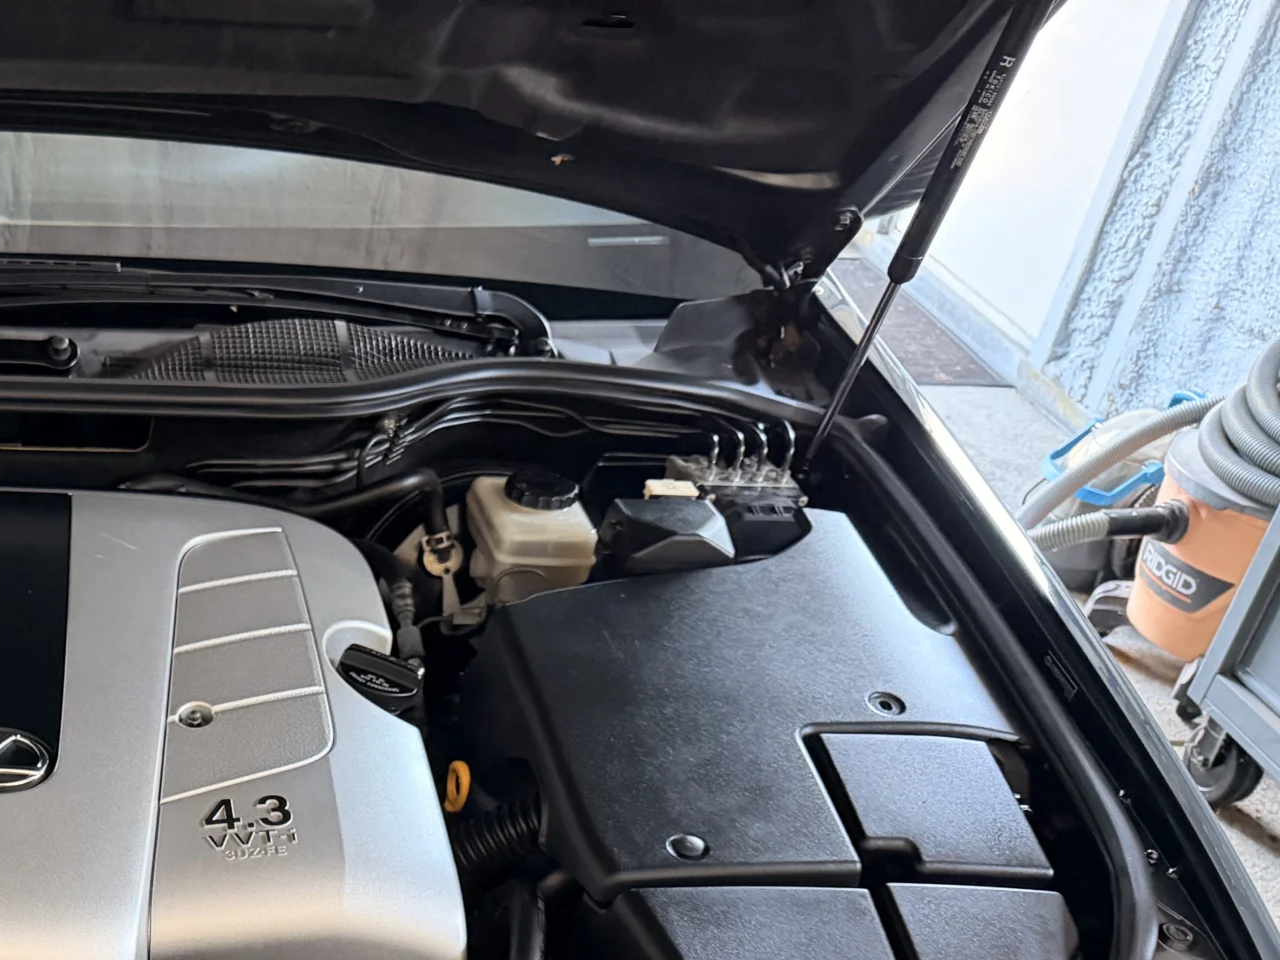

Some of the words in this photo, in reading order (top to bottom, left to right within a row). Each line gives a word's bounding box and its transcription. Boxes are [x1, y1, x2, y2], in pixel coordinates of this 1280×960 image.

[999, 55, 1016, 68] R
[982, 74, 1001, 104] TOKICO
[1142, 542, 1197, 595] RIDGID
[203, 795, 294, 832] 4.3
[206, 828, 298, 851] VVT-i
[224, 845, 288, 861] 3UZ-FE
